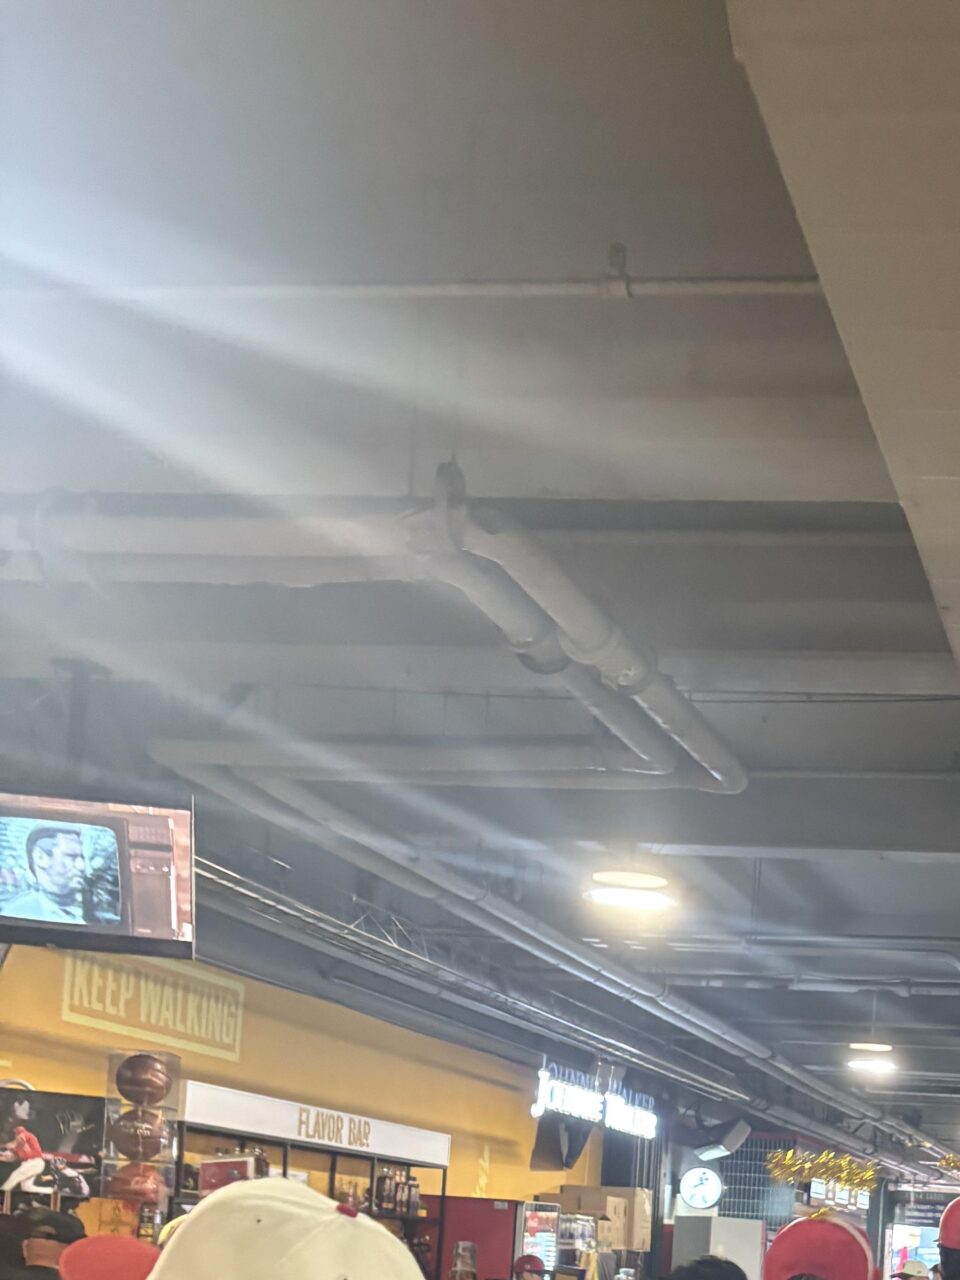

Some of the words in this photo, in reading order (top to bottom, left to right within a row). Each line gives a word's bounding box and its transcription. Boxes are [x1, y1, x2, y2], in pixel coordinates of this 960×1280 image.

[73, 957, 135, 1018] KEEP
[140, 974, 238, 1045] WALKING
[297, 1106, 344, 1144] FLAVOR
[347, 1117, 371, 1147] BAR
